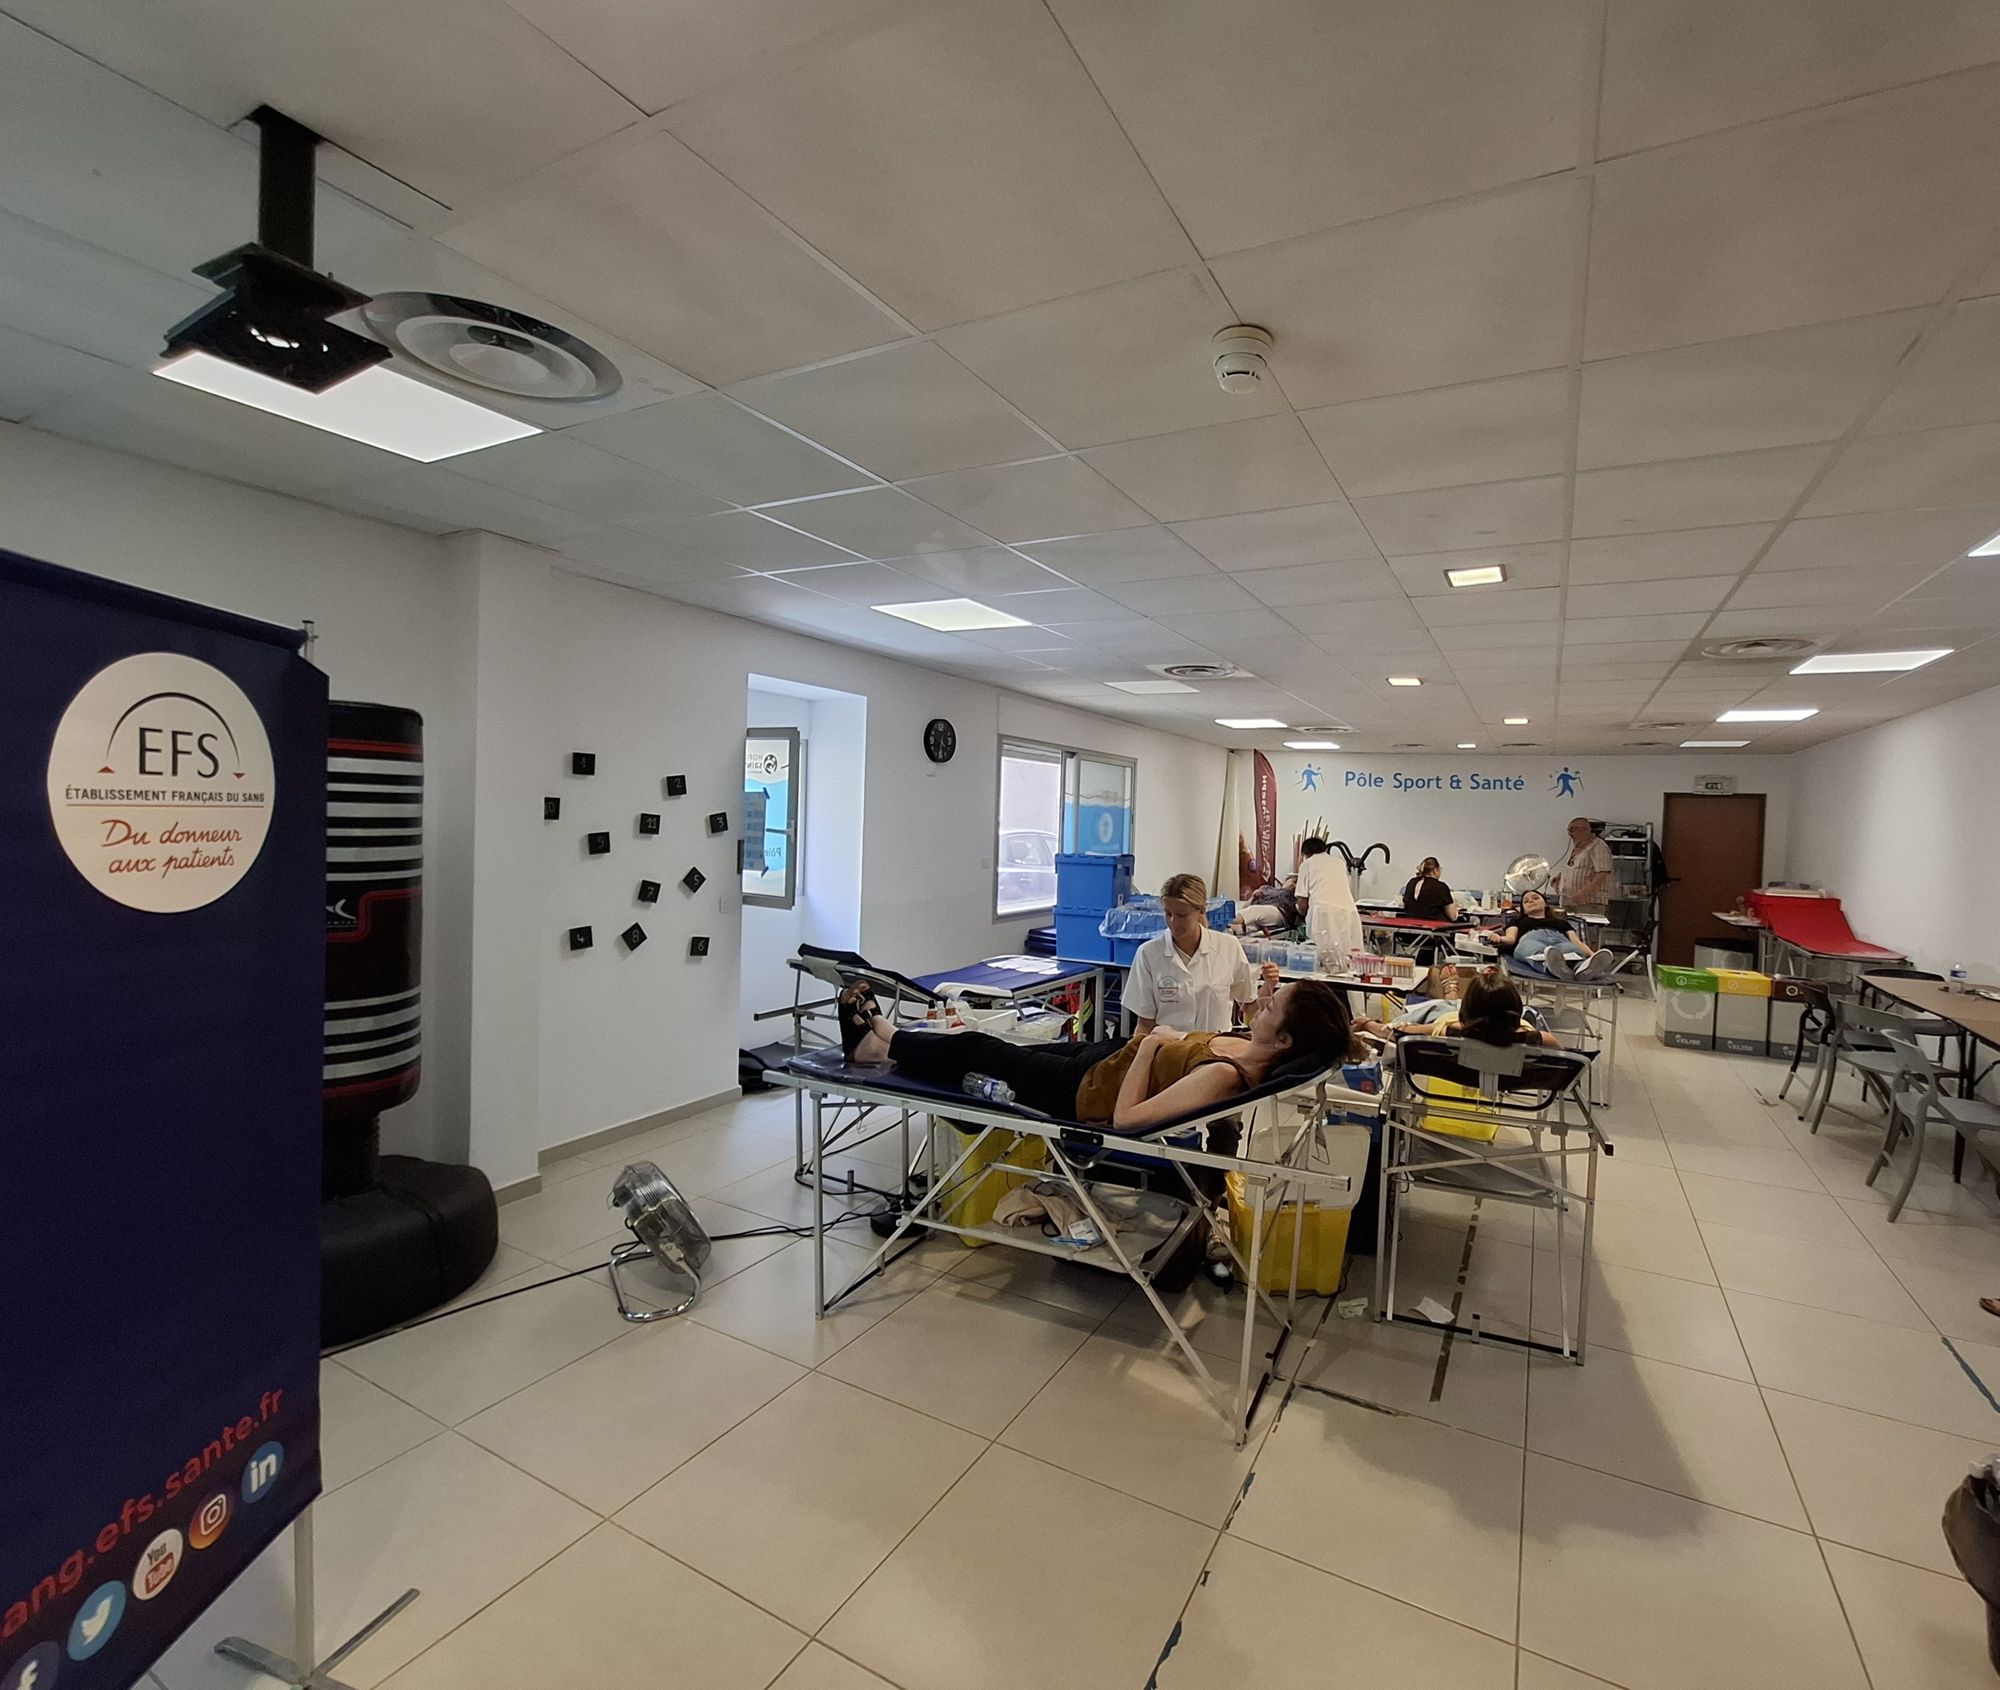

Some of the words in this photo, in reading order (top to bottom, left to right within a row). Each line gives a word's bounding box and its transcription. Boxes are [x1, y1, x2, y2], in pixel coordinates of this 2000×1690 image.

[138, 727, 220, 779] EFS
[674, 778, 682, 788] 2
[1344, 771, 1384, 788] Pôle
[1393, 773, 1443, 792] Sport
[1449, 775, 1462, 790] &
[1470, 774, 1525, 791] Santé
[65, 784, 168, 801] ÉTABLISSEMENT
[171, 791, 223, 805] FRANÇAIS
[226, 792, 239, 802] DU
[242, 793, 265, 803] SANG
[646, 818, 657, 829] 11
[716, 817, 724, 828] 3
[101, 819, 150, 847] Du
[159, 821, 242, 844] donneur
[109, 858, 156, 874] aux
[162, 846, 235, 879] patients
[693, 874, 699, 885] 5
[576, 933, 585, 944] 4
[632, 930, 640, 943] 8
[697, 940, 704, 952] 6
[250, 1452, 277, 1494] in
[147, 1542, 167, 1566] You
